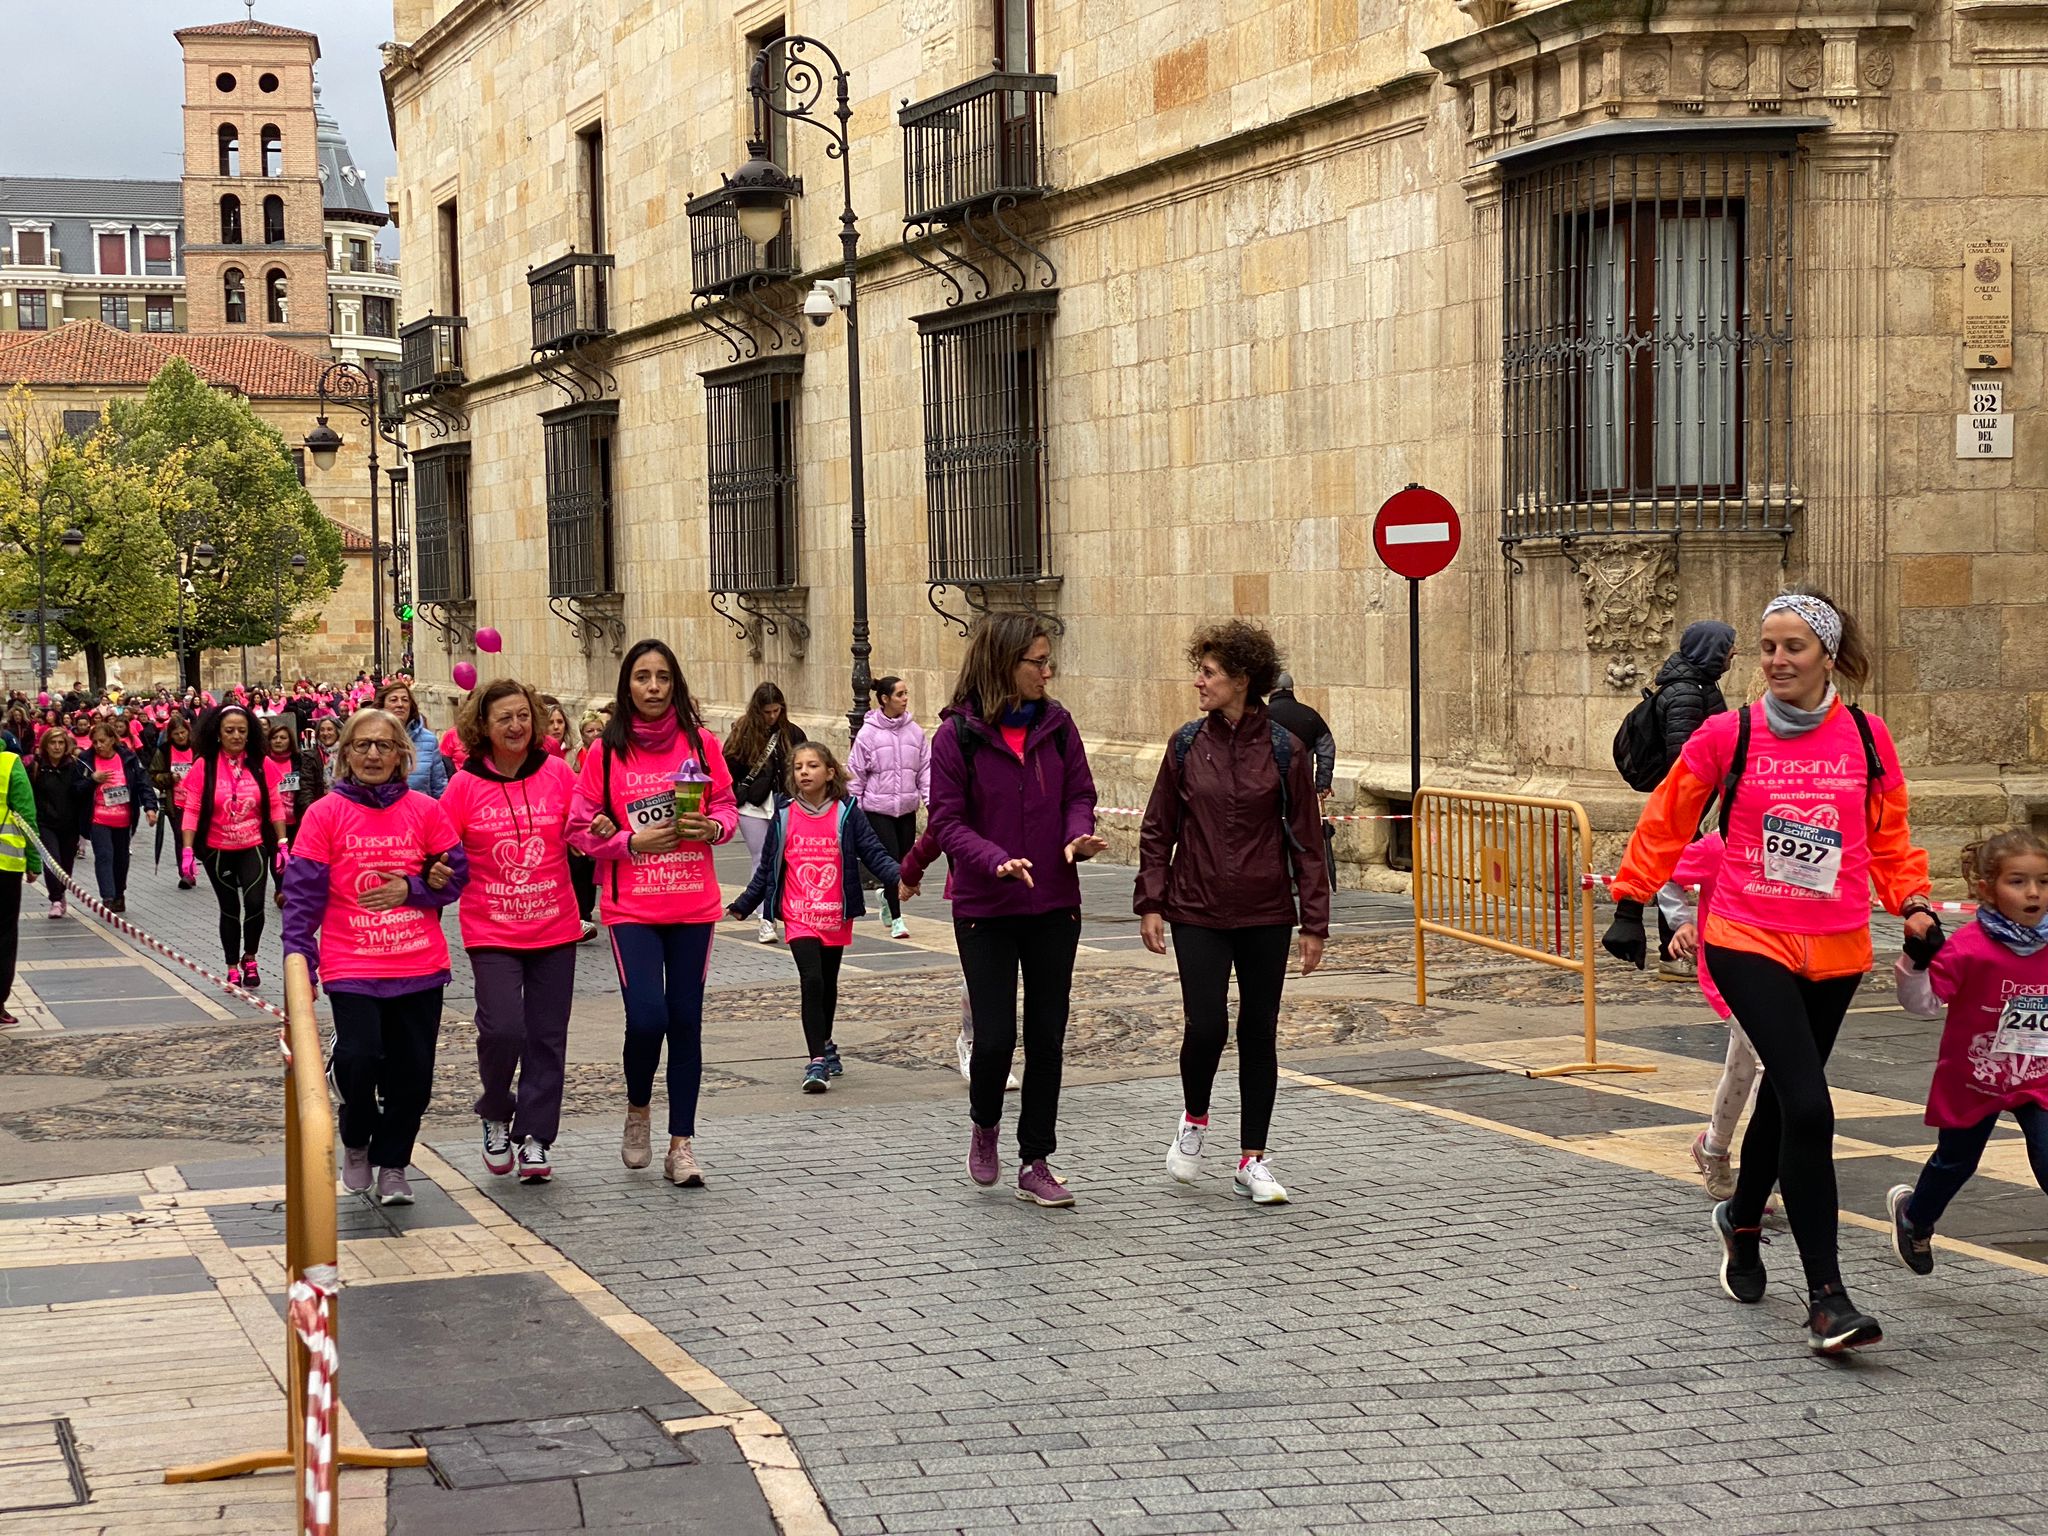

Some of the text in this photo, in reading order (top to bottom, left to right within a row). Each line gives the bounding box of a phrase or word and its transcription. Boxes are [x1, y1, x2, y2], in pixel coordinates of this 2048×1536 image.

[1973, 394, 1998, 413] 82
[1972, 419, 1998, 429] CALLE
[1978, 431, 1993, 441] DEL
[1756, 754, 1849, 775] Drasanvi
[637, 803, 676, 825] 003
[1785, 821, 1820, 834] GRUPO
[345, 829, 413, 850] Drasanvi
[650, 851, 705, 865] CARRERA
[1766, 835, 1830, 865] 6927
[644, 867, 692, 885] Mujer
[485, 879, 558, 896] VIII CARRERA
[500, 897, 548, 914] Mujer
[348, 915, 370, 928] VIII
[370, 910, 425, 927] CARRERA
[364, 928, 416, 946] Mujer
